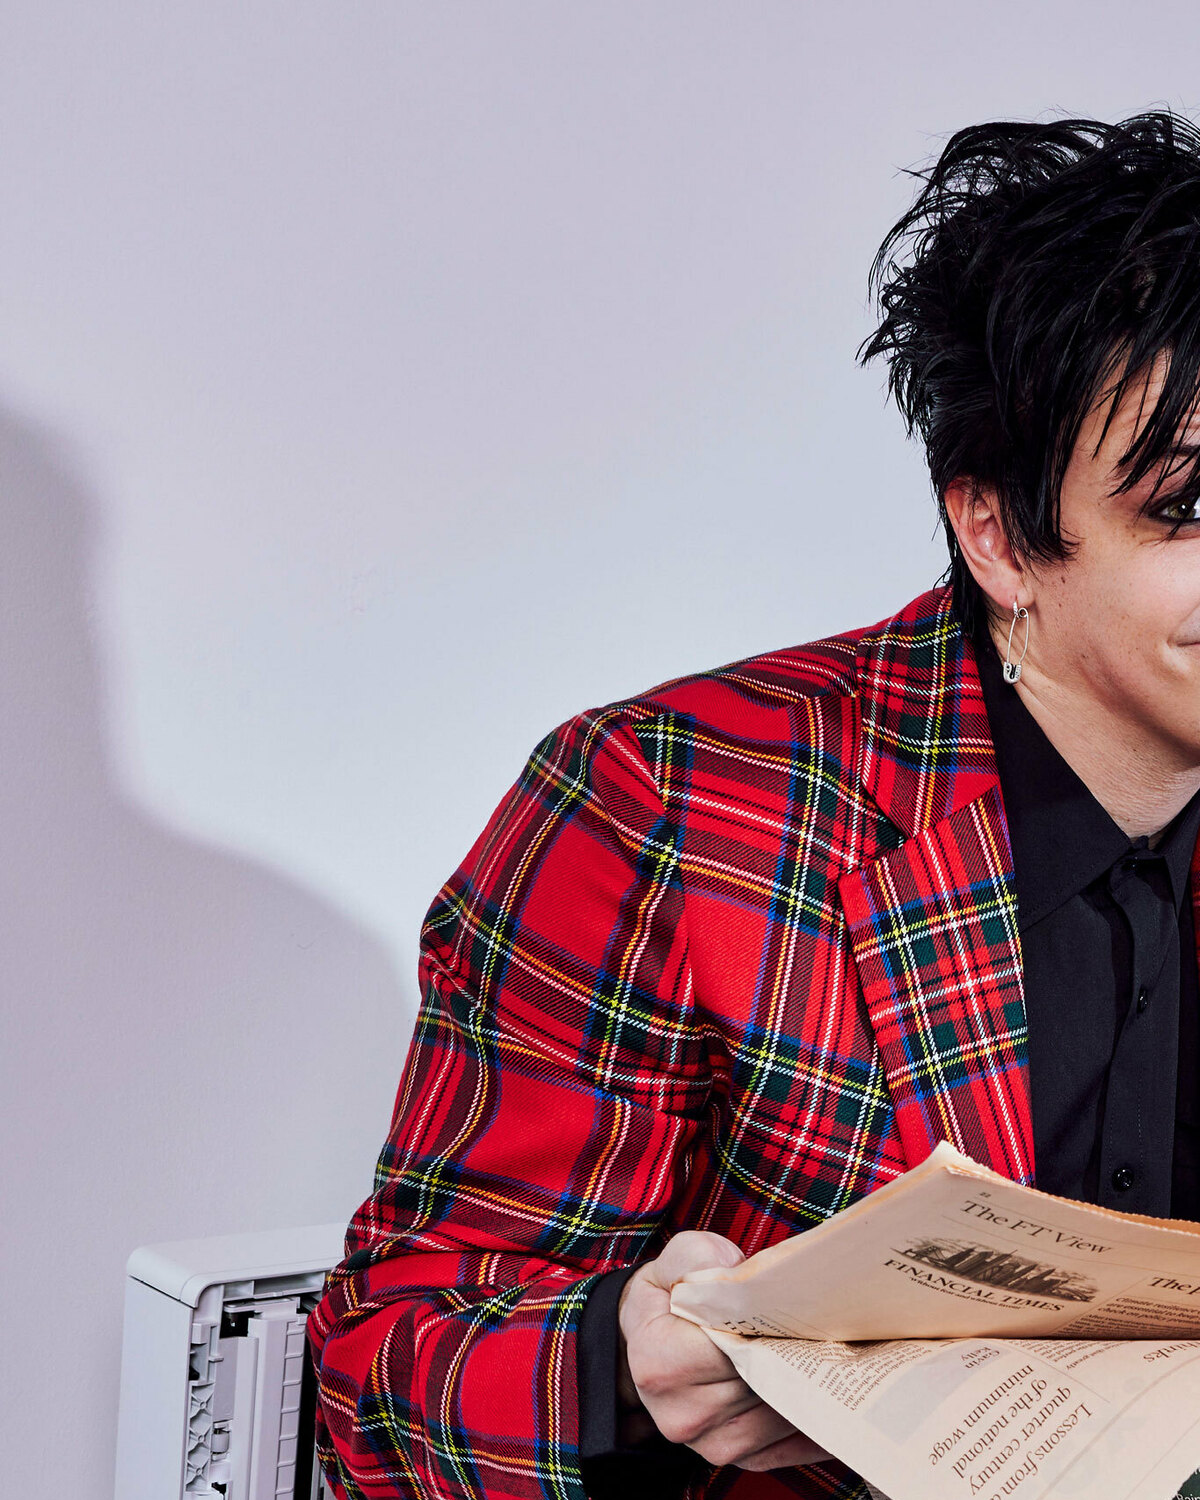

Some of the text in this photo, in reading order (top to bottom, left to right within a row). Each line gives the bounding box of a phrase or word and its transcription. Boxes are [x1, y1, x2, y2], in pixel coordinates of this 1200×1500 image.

[960, 1200, 1112, 1255] The FT View
[883, 1259, 995, 1301] FINANCIAL
[1005, 1295, 1065, 1312] TIMES
[1150, 1276, 1192, 1290] The
[928, 1365, 1035, 1466] minimum wage
[951, 1379, 1048, 1479] of the national
[970, 1387, 1071, 1497] quarter century
[1034, 1402, 1092, 1461] Lessons
[999, 1451, 1039, 1495] from
